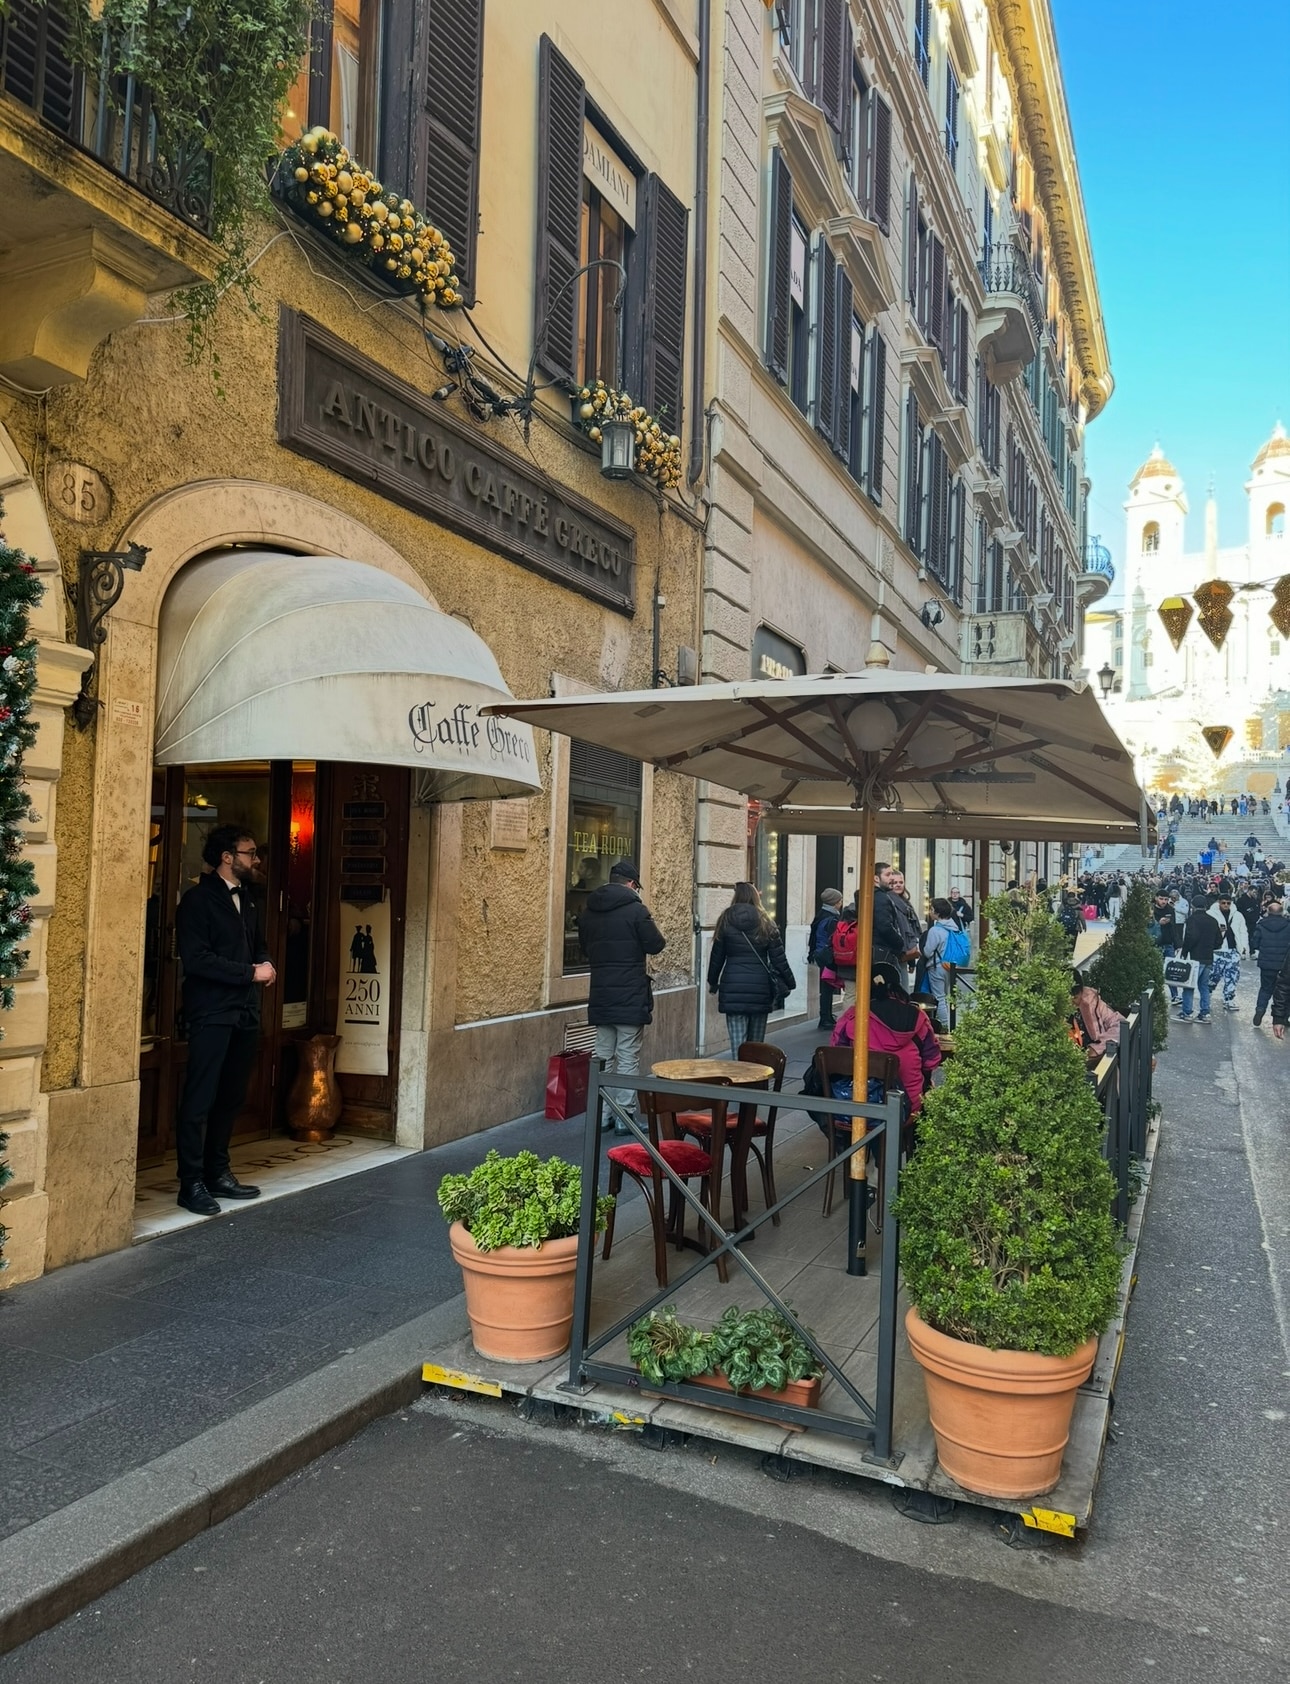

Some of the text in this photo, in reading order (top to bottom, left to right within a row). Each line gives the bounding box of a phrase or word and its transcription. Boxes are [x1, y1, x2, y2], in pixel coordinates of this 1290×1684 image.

[323, 380, 455, 481] ANTICO
[554, 516, 623, 578] GRECO
[62, 473, 96, 512] 85
[574, 831, 632, 857] TEA ROOM
[345, 978, 381, 1003] 250
[344, 1003, 380, 1017] ANNI
